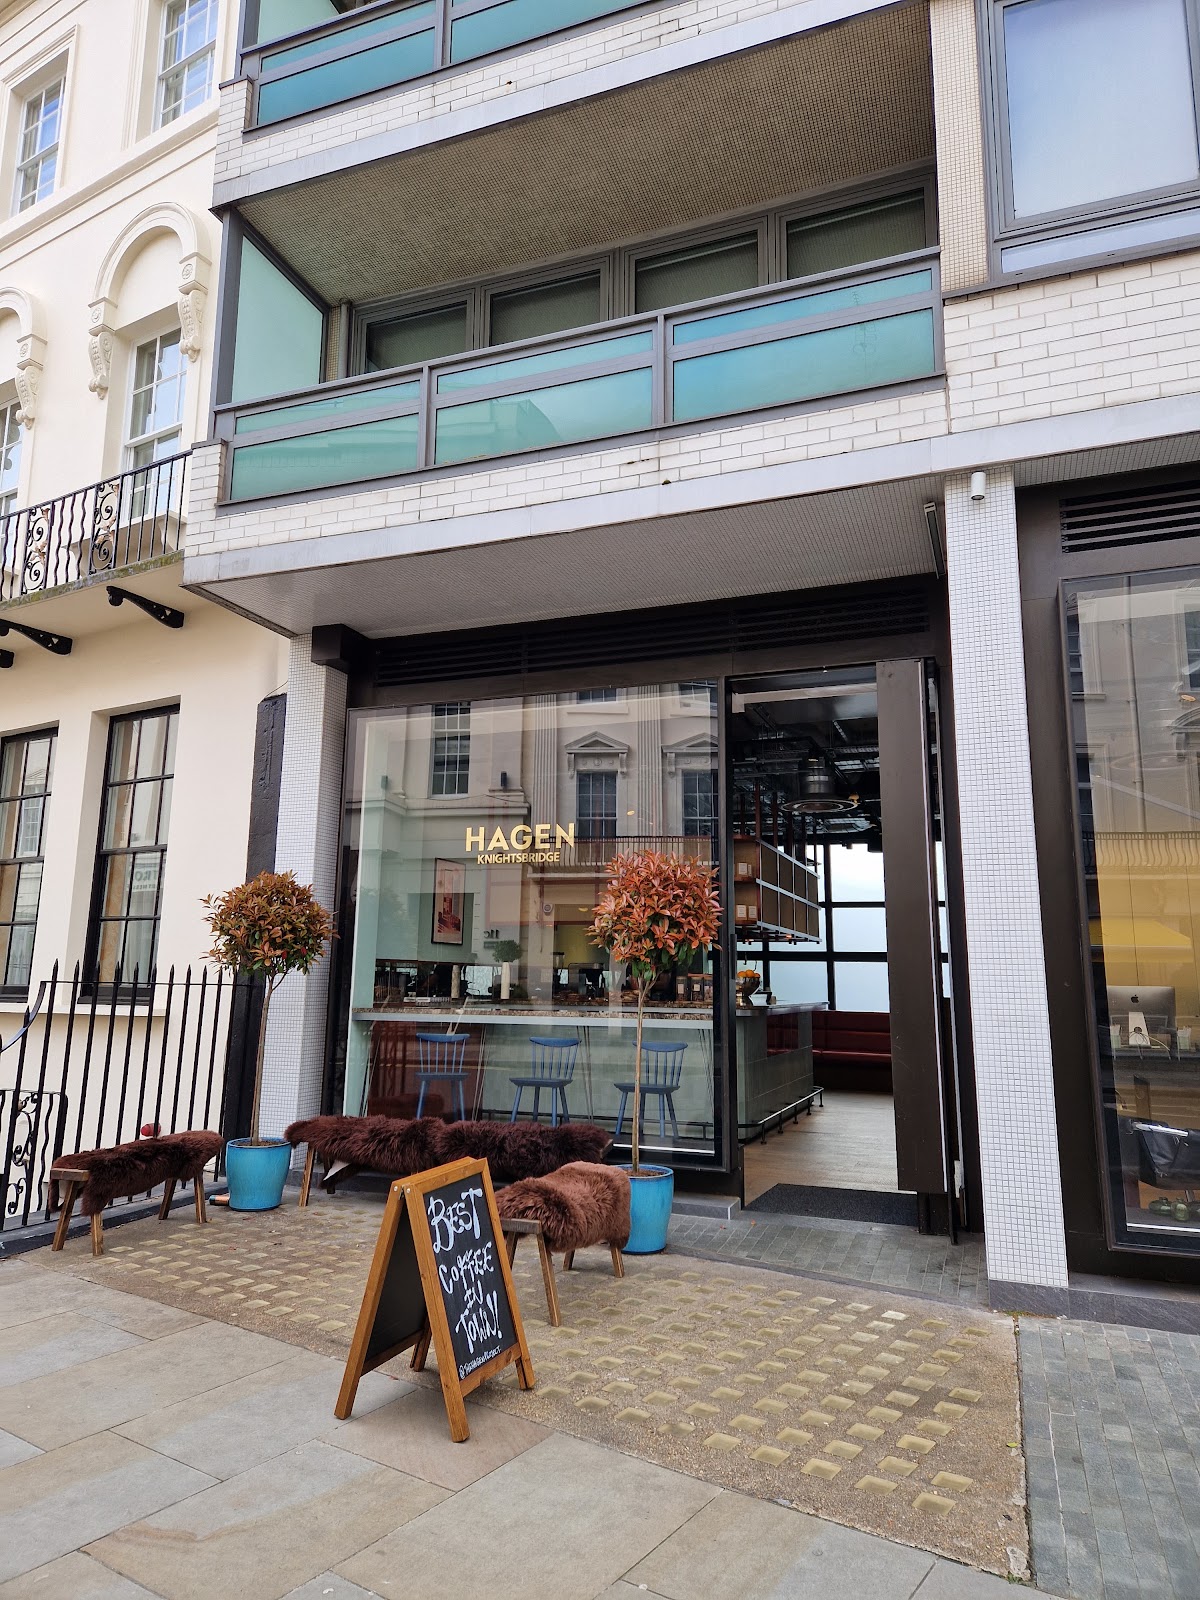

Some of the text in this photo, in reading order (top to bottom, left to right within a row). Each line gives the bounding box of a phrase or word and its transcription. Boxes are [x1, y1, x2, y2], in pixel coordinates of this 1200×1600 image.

[465, 823, 575, 852] HAGEN
[477, 852, 560, 864] KNIGHTSBRIDGE
[428, 1188, 483, 1253] BEST
[464, 1280, 484, 1310] IN
